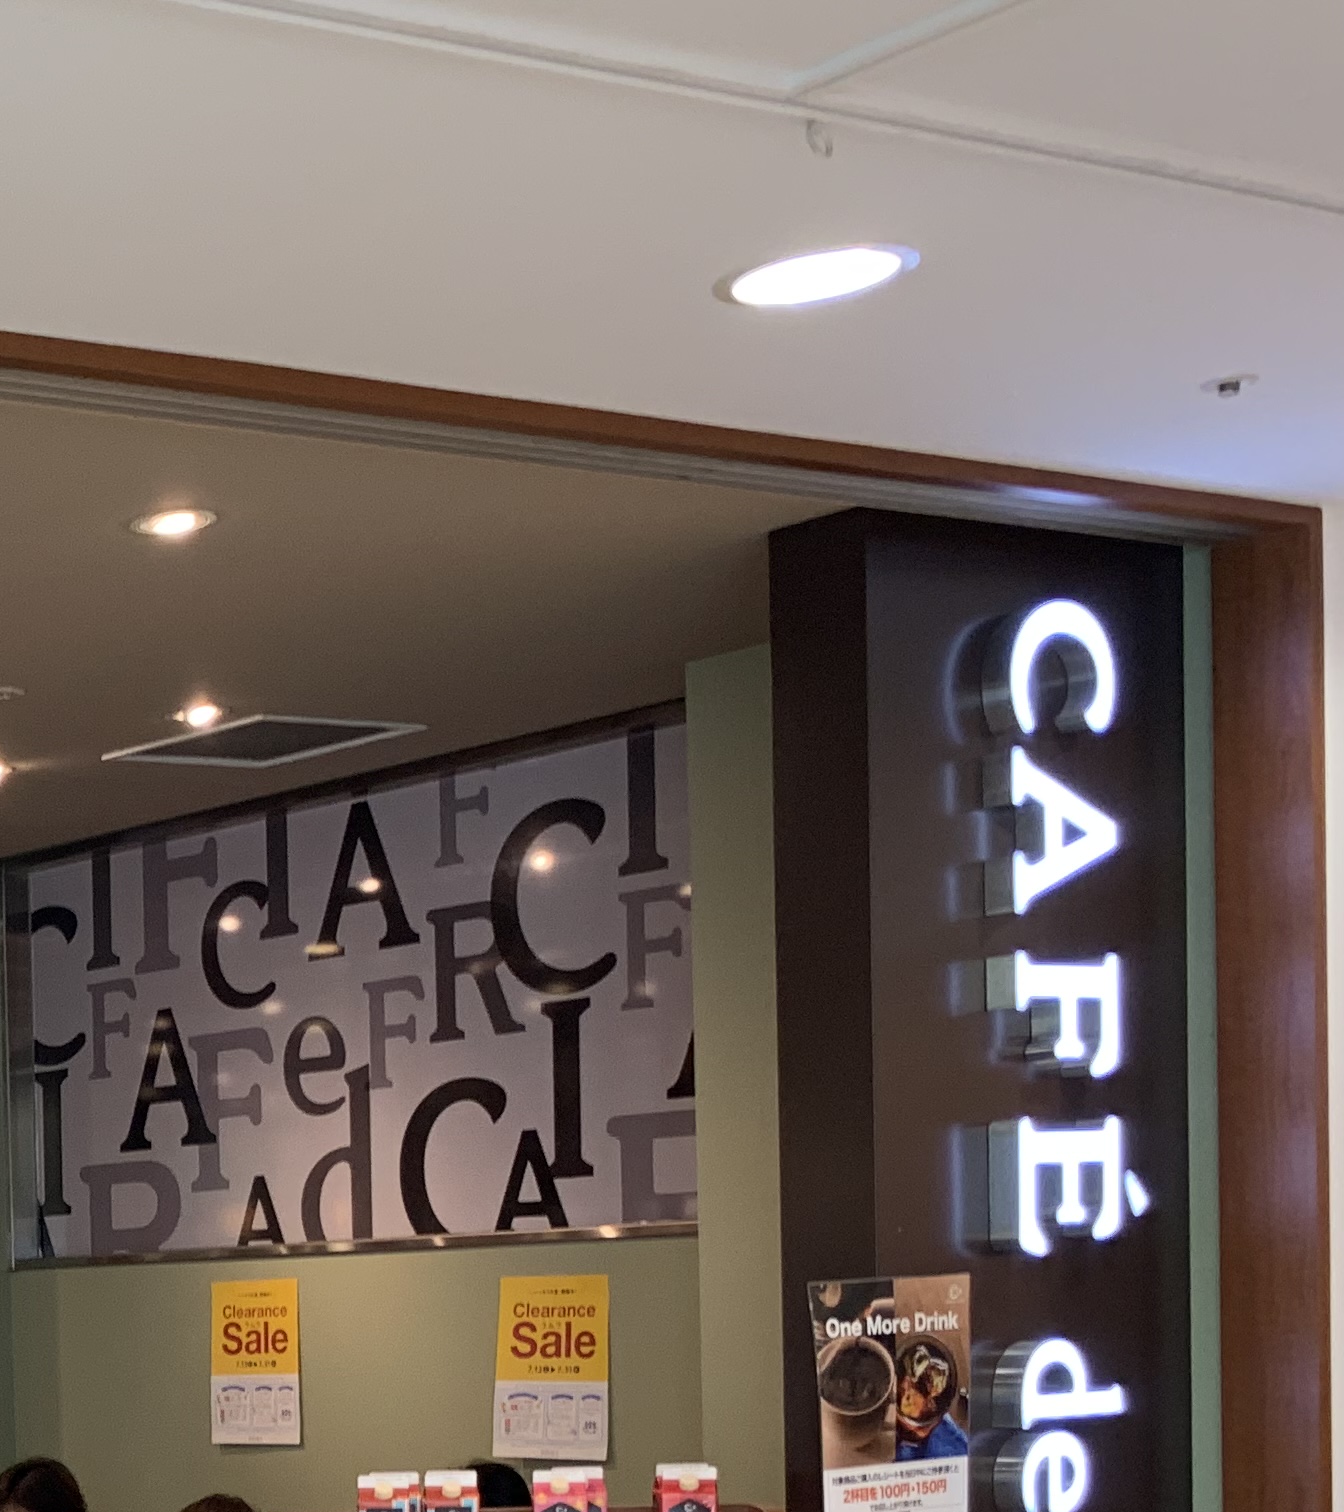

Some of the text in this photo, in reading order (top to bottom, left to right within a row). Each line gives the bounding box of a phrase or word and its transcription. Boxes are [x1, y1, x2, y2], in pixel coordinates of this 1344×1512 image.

[308, 798, 420, 961] A
[490, 798, 617, 994] C
[1010, 597, 1150, 1257] CAFÉ
[201, 880, 276, 1008] C
[426, 901, 524, 1042] R
[87, 978, 136, 1080] F
[120, 1008, 216, 1152] A
[284, 1016, 345, 1116] e
[363, 976, 424, 1089] F
[542, 997, 593, 1178] I
[189, 1027, 273, 1192] F
[301, 1062, 373, 1241] d
[400, 1077, 507, 1235] C
[237, 1175, 285, 1246] A
[496, 1130, 570, 1231] A
[221, 1321, 289, 1357] Sale
[223, 1304, 288, 1320] Clearance
[510, 1321, 597, 1359] Sale
[513, 1302, 597, 1319] Clearance
[826, 1311, 959, 1339] One More Drink
